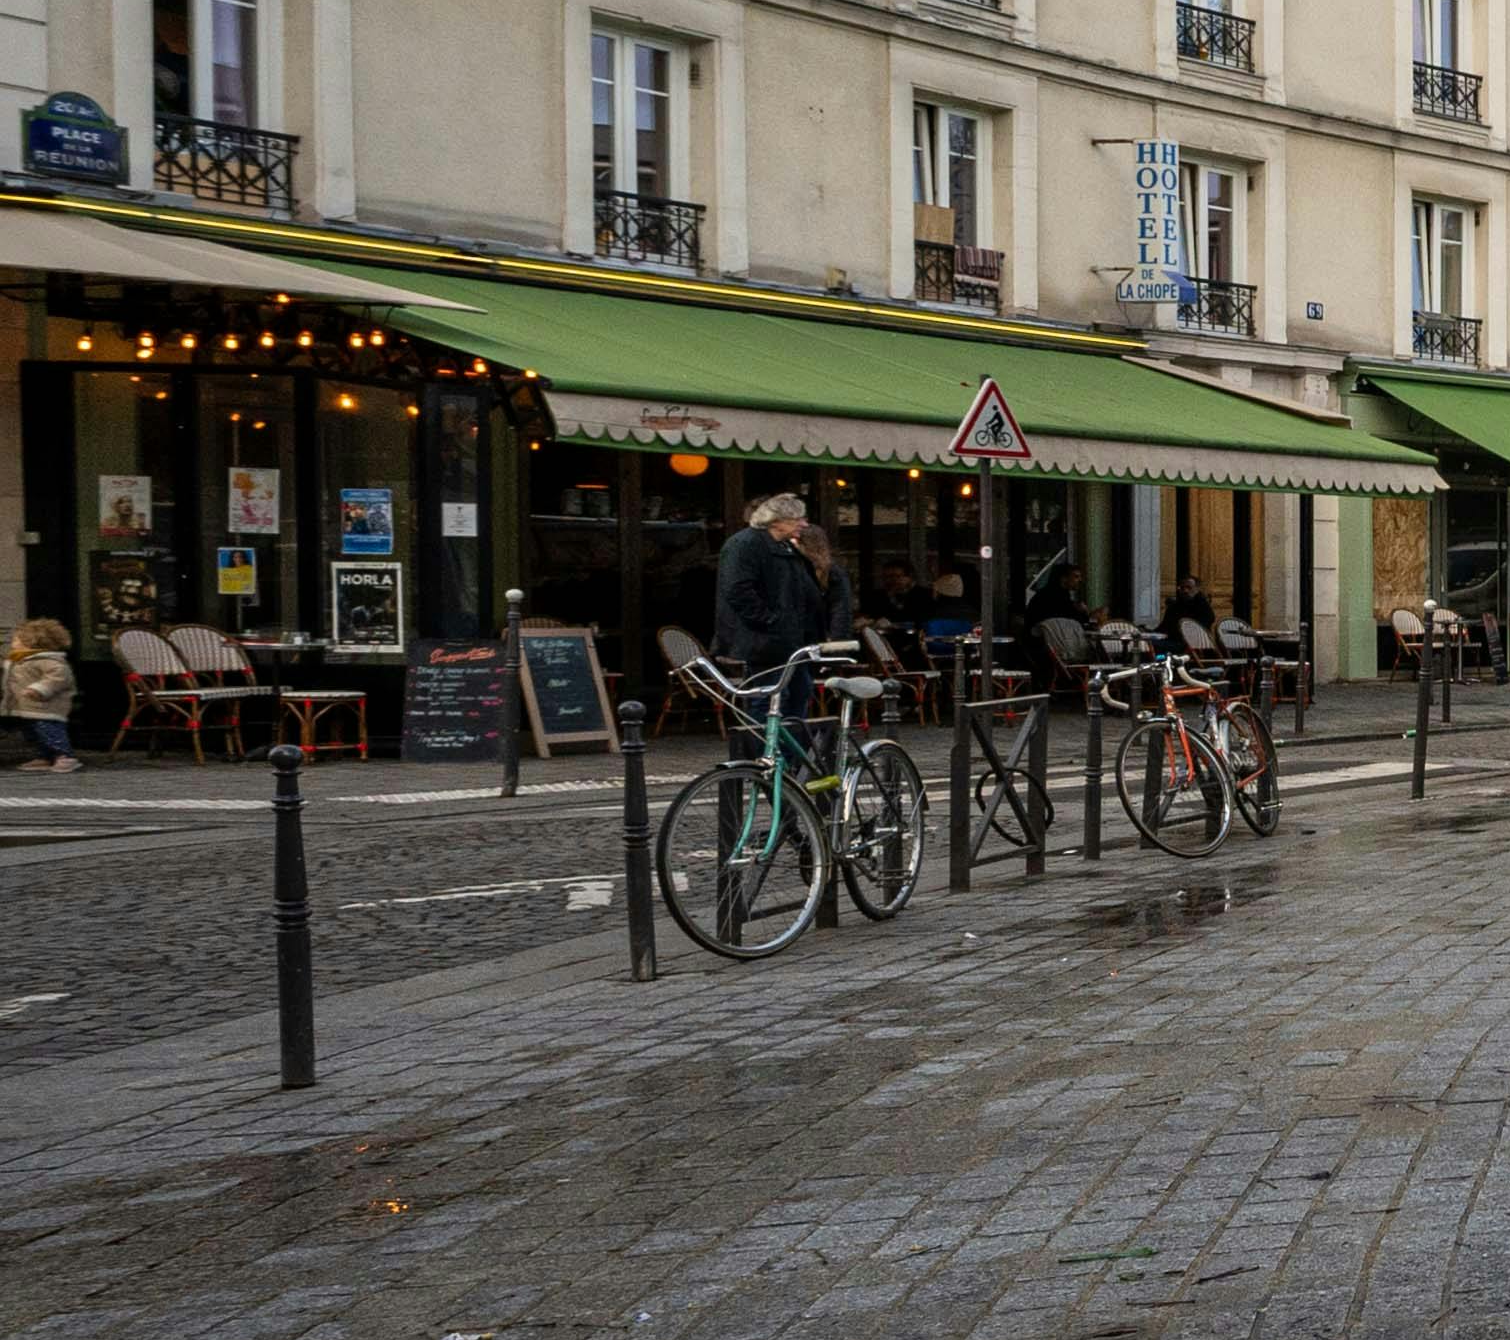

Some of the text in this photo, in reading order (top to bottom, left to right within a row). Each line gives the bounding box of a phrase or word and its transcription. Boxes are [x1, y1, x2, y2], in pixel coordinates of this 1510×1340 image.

[51, 126, 102, 144] PLACE
[1136, 142, 1158, 265] HOTEL
[1161, 143, 1178, 266] HOTEL
[1141, 268, 1154, 280] DE
[1119, 283, 1178, 299] LA CHOPE
[1308, 303, 1322, 318] 69
[340, 574, 394, 586] HORLA
